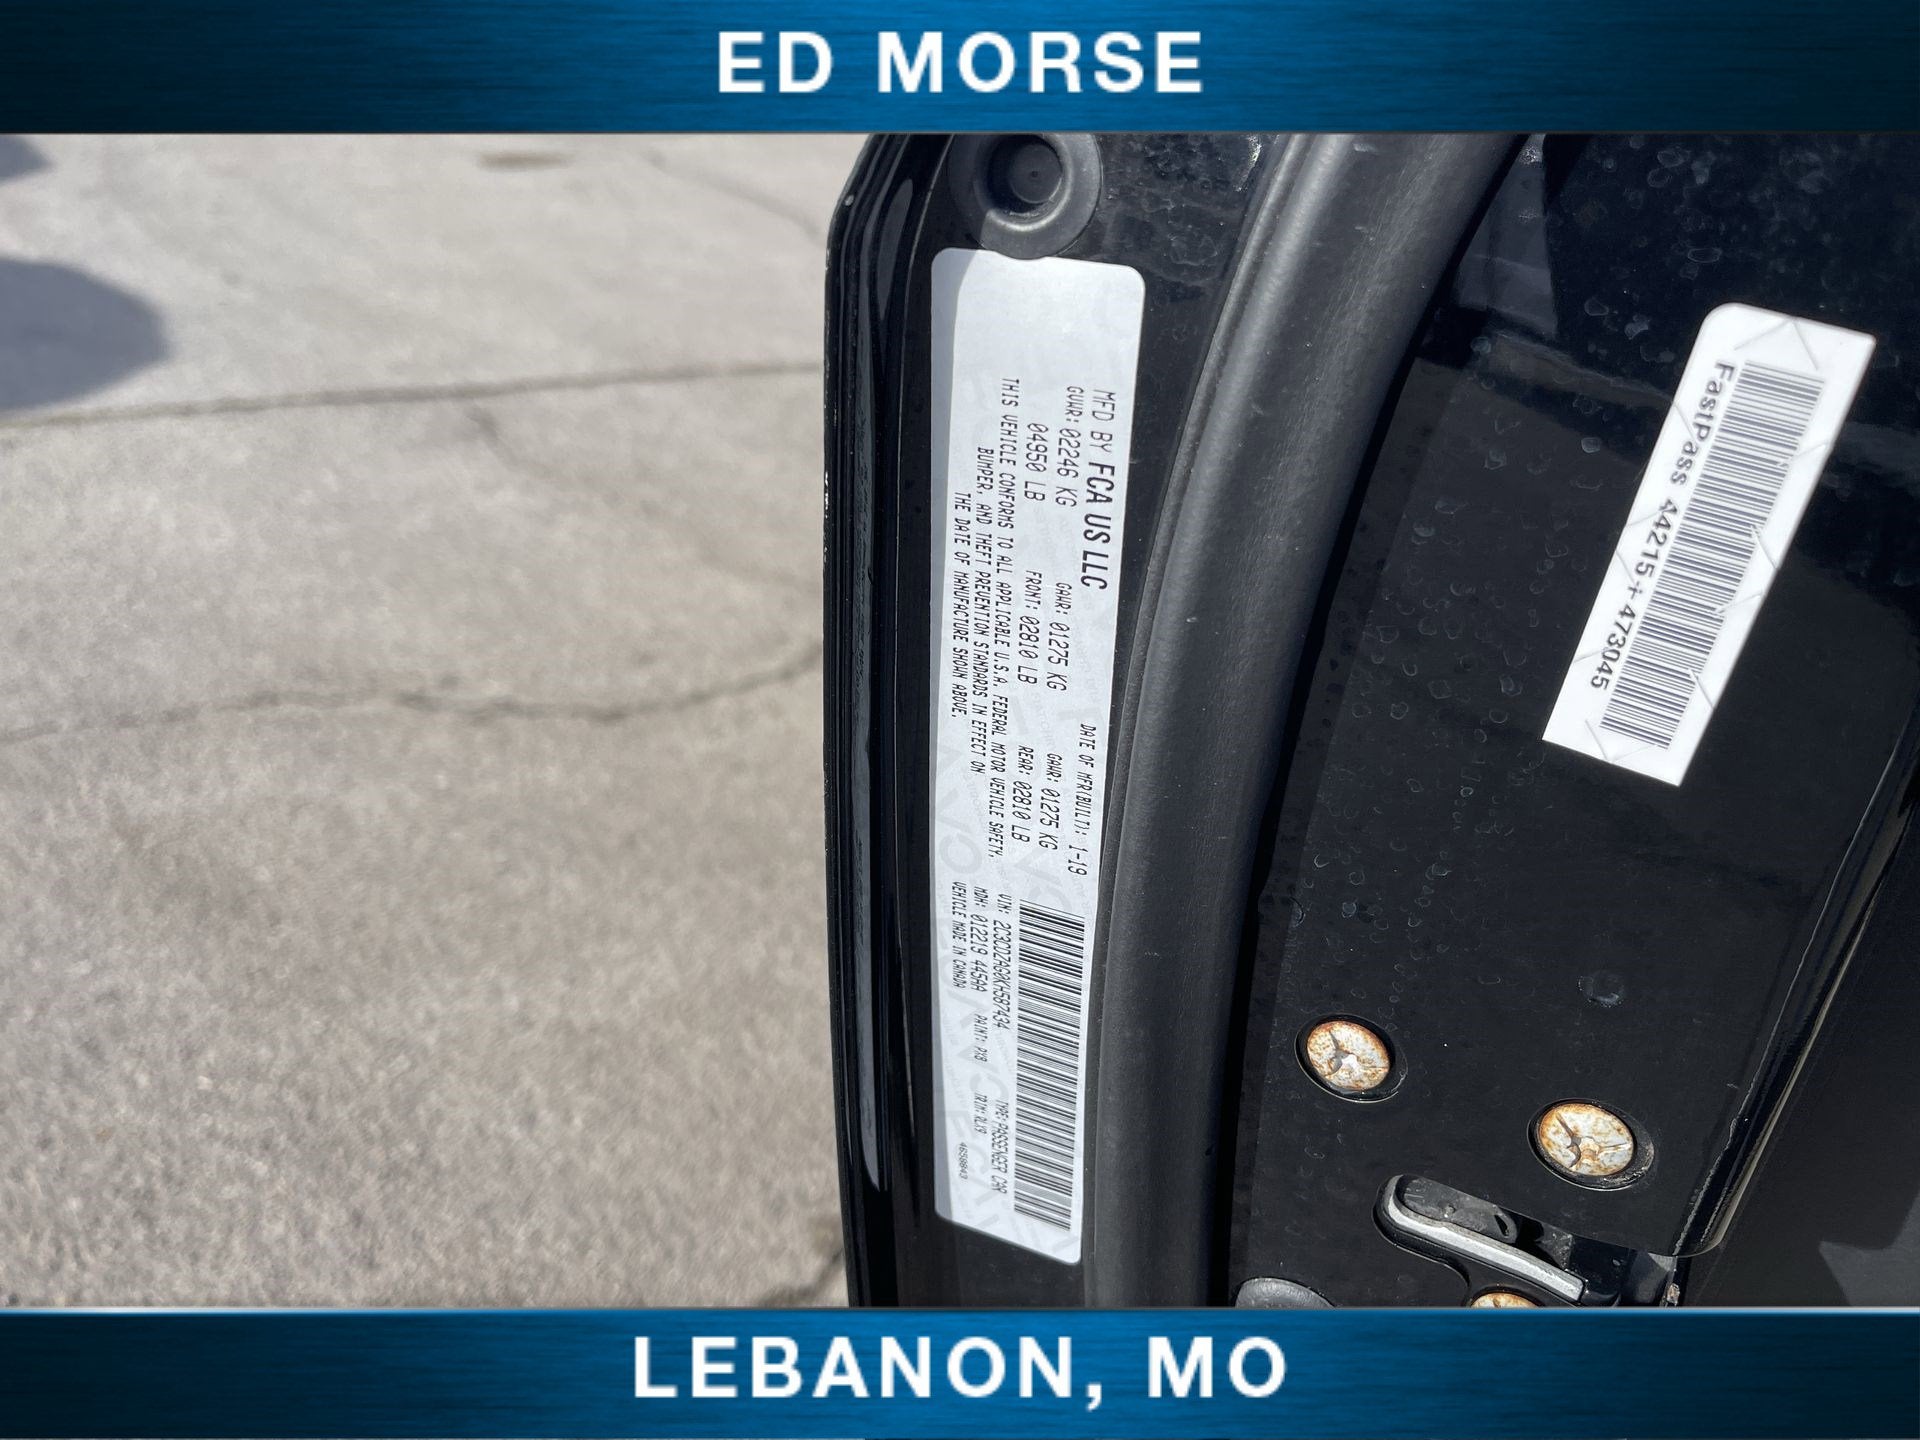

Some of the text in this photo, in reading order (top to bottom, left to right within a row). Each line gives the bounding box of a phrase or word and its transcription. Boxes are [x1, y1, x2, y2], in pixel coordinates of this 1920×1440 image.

[1002, 378, 1019, 407] THIS
[1000, 414, 1017, 465] VEHICLE
[1670, 362, 1737, 486] FastPass
[1025, 423, 1048, 501] 04950 LB
[1055, 386, 1084, 507] GVWR: 02246 KG
[955, 492, 971, 510] THE
[998, 472, 1015, 528] CONFORMS
[1081, 390, 1115, 589] MFD BY FCA US LLC
[954, 518, 970, 546] DATE
[976, 503, 992, 524] AND
[954, 552, 970, 565] OF
[975, 533, 992, 565] THEFT
[997, 536, 1013, 549] TO
[997, 556, 1012, 574] ALL
[952, 571, 969, 642] MANUFACTURE
[973, 571, 990, 636] PREVENTION
[994, 582, 1011, 647] APPLICABLE
[1018, 570, 1042, 684] FRONT: 02810 LB
[1047, 582, 1072, 691] GAWR: 01275 KG
[952, 647, 968, 678] SHOWN
[972, 641, 989, 697] STANDARDS
[972, 703, 987, 715] IN
[991, 694, 1008, 736] FEDERAL
[971, 720, 986, 756] EFFECT
[1080, 724, 1096, 750] DATE
[971, 760, 985, 774] ON
[990, 742, 1005, 772] MOTOR
[1079, 754, 1094, 768] OF
[989, 778, 1005, 816] VEHICLE
[1011, 745, 1034, 842] REAR: 02810 LB
[1039, 753, 1062, 850] GAWR: 01275 KG
[1074, 772, 1093, 835] MFR(BUILT):
[1068, 845, 1088, 875] 1-19
[998, 894, 1012, 913] VIN:
[952, 882, 966, 988] VEHICLE MADE IN CANADA
[971, 914, 988, 955] 012219
[974, 1014, 987, 1042] PAINT:
[992, 1100, 1009, 1194] TYPE: PASSENGER CAR
